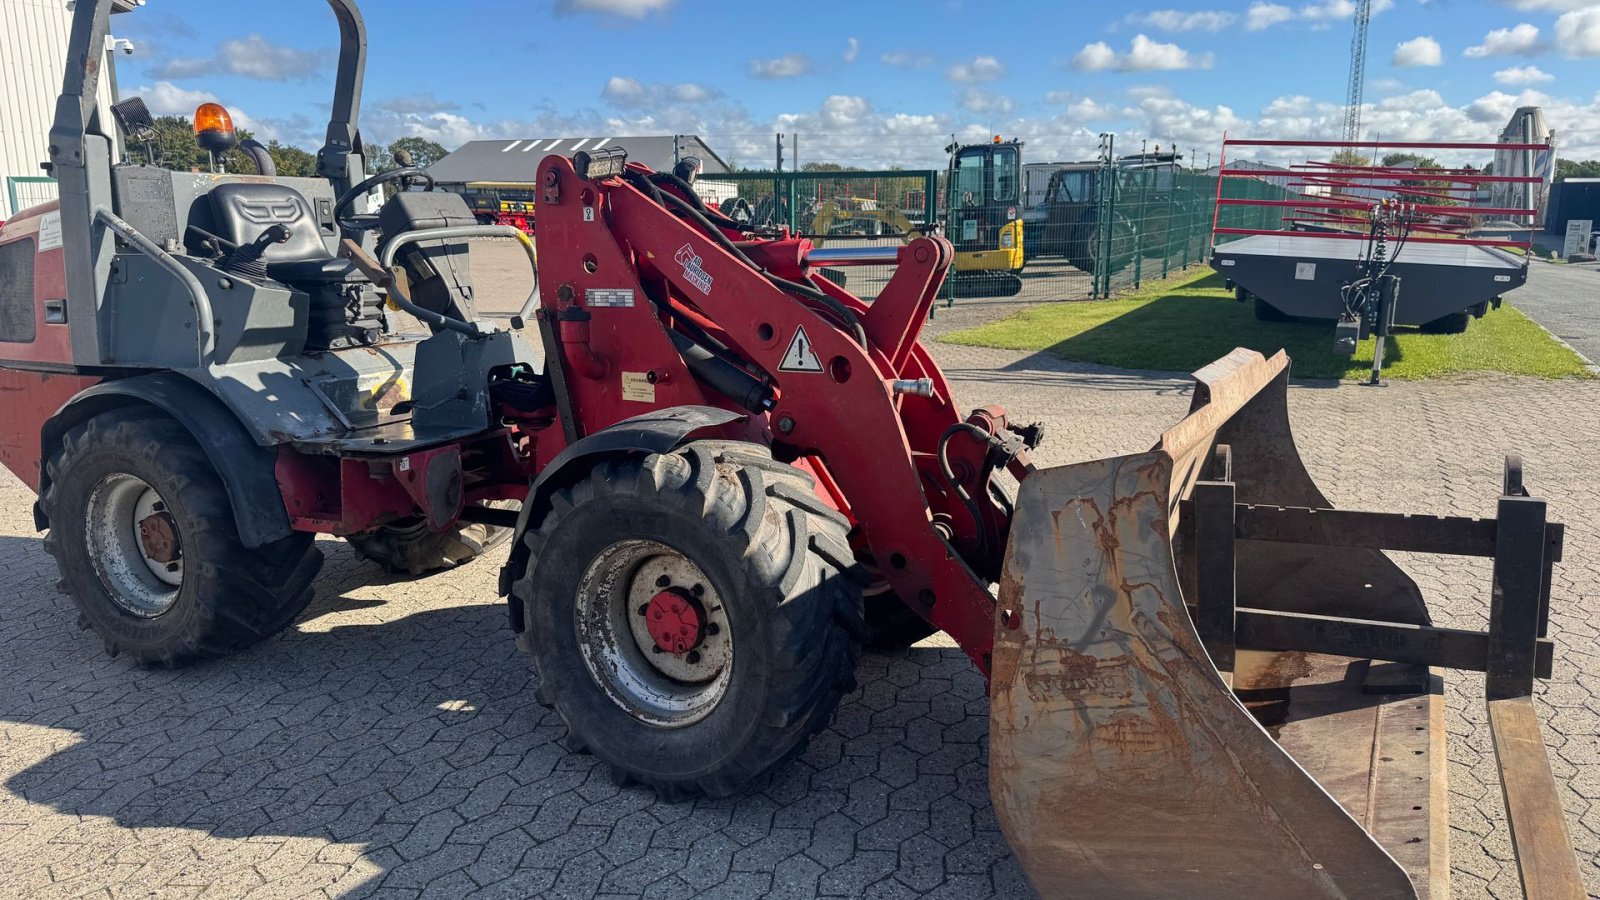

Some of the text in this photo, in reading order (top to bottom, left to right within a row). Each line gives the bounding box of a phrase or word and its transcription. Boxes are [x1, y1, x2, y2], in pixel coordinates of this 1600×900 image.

[693, 256, 702, 267] AB
[684, 269, 711, 294] MASKINER
[1036, 676, 1115, 692] VOLVO
